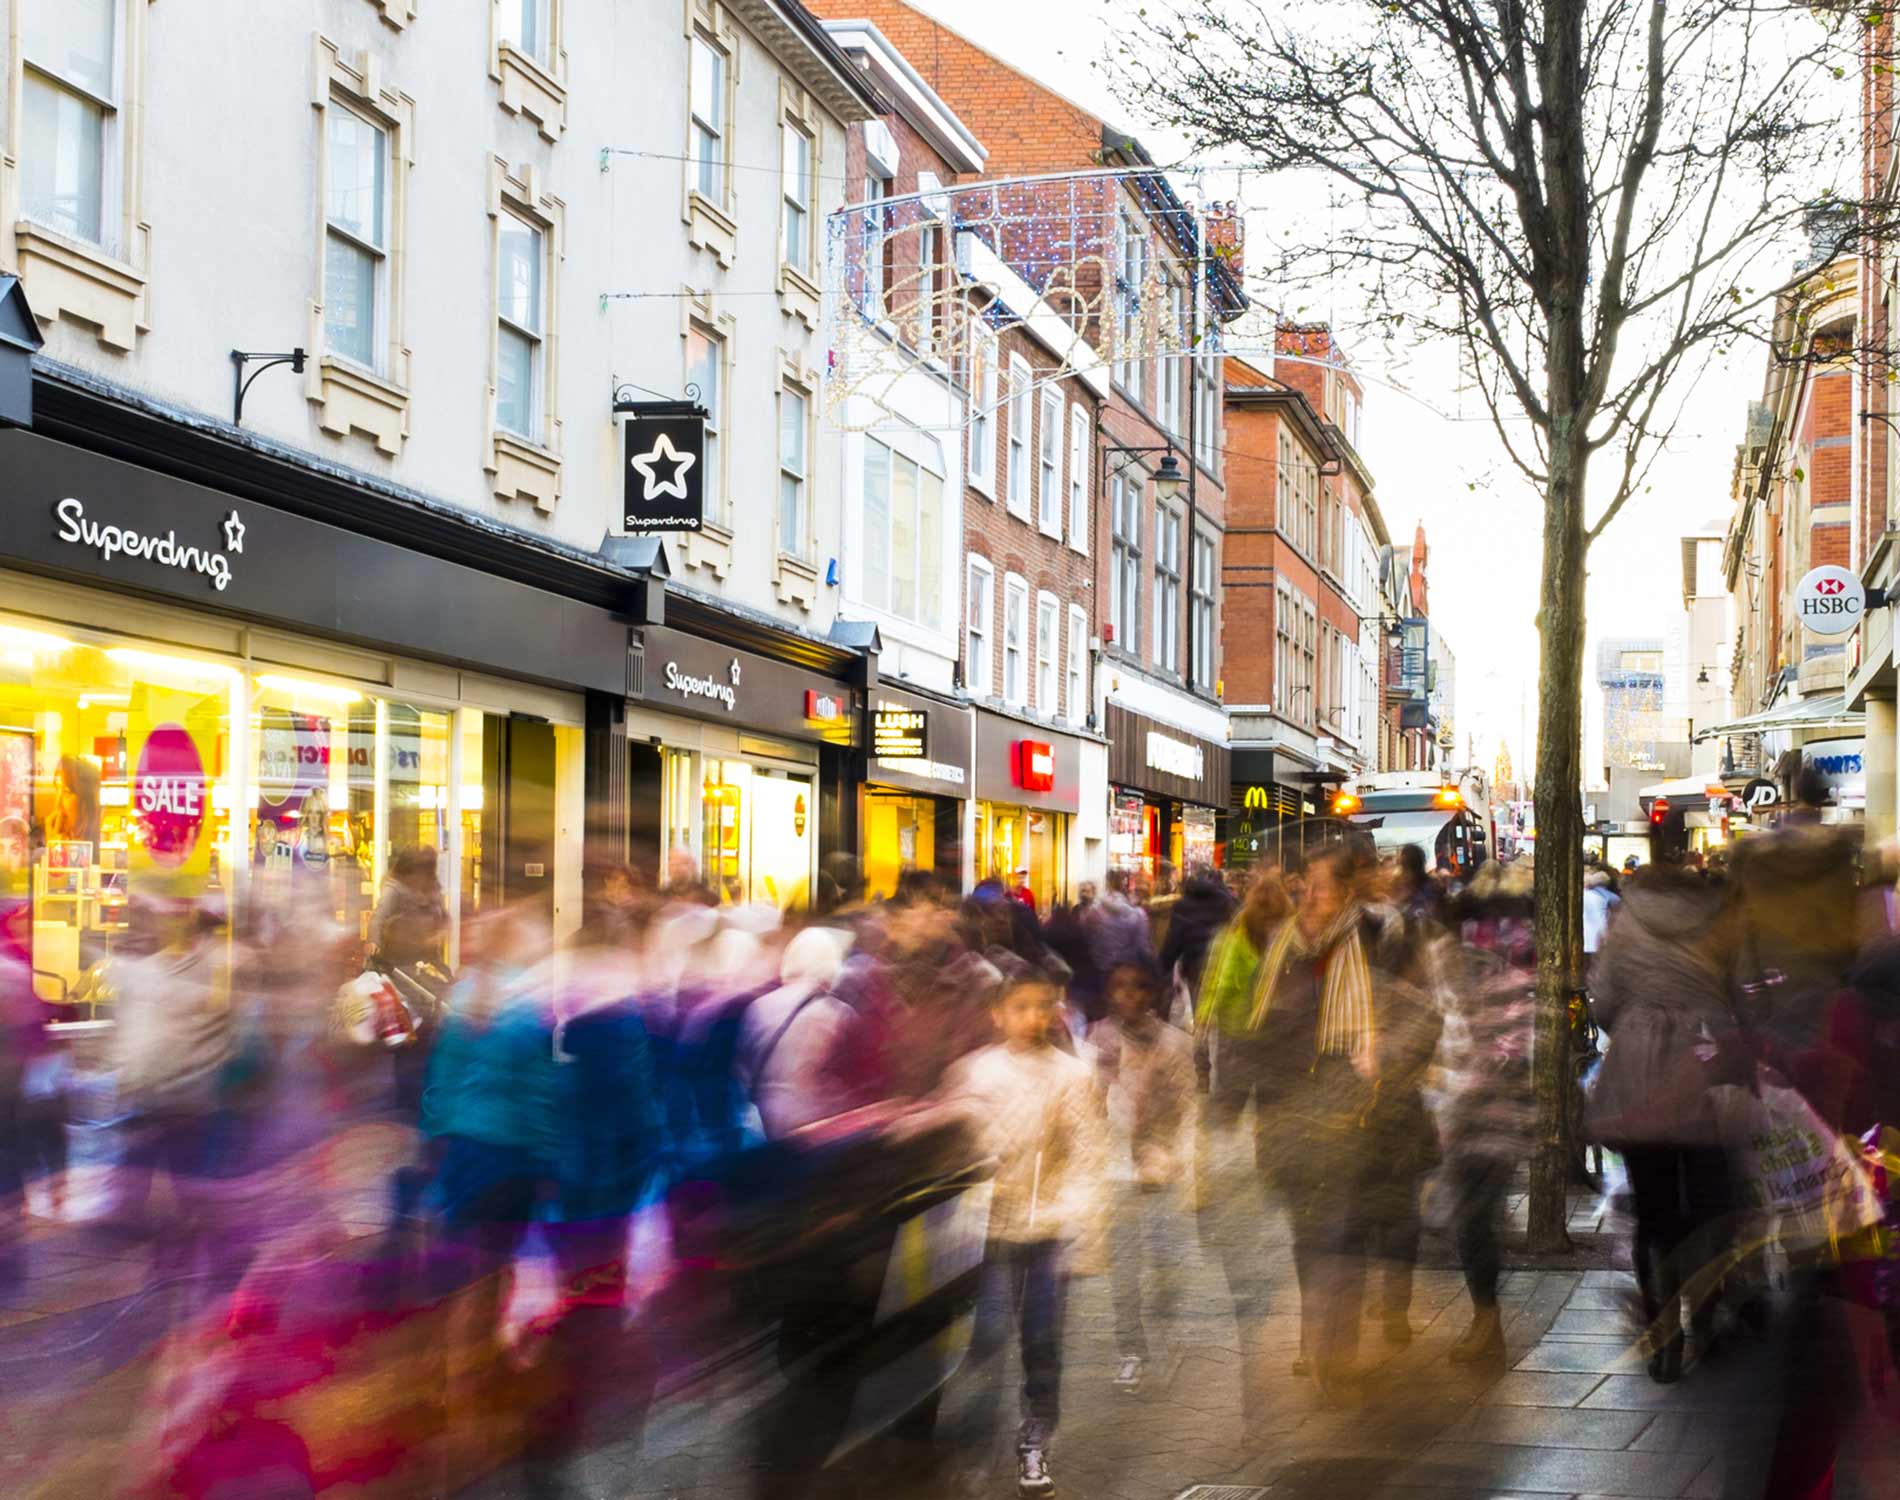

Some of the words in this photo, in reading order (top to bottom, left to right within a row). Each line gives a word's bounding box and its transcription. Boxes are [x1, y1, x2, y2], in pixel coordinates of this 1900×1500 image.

[625, 515, 700, 528] Superdrug
[56, 497, 233, 591] Superdrug
[1802, 596, 1860, 616] HSBC
[665, 661, 736, 710] Superdrug
[874, 713, 925, 729] LUSH
[1628, 751, 1651, 764] John
[1637, 761, 1666, 771] Lewis
[141, 776, 200, 816] SALE
[1747, 785, 1777, 807] JD
